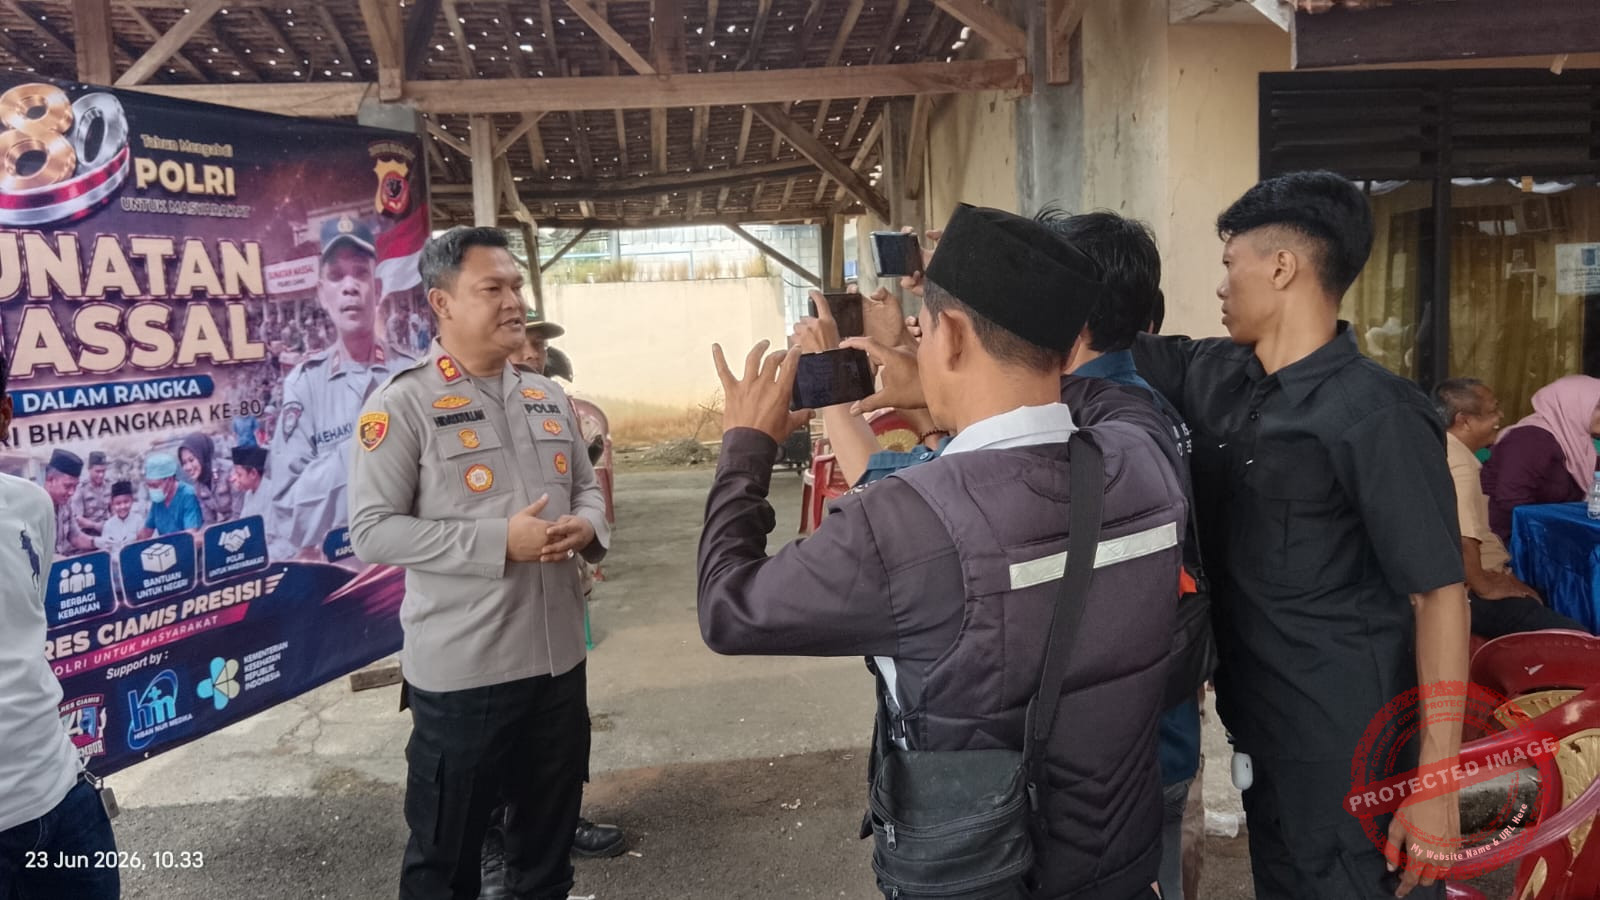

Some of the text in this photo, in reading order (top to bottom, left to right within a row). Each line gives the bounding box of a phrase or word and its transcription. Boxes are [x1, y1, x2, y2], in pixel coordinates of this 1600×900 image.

[134, 157, 236, 196] POLRI
[120, 197, 168, 212] UNTUK
[22, 379, 202, 412] DALAM RANGKA
[524, 403, 561, 414] POLRI
[29, 407, 202, 444] BHAYANGKARA
[136, 579, 189, 600] UNTUK NEGERI
[143, 572, 182, 589] BANTUAN
[58, 602, 100, 620] KEBAIKAN
[60, 593, 97, 610] BERBAGI
[97, 605, 178, 646] CIAMIS
[181, 580, 262, 619] PRESISI
[94, 643, 136, 664] UNTUK
[141, 615, 219, 651] MASYARAKAT
[106, 654, 148, 680] Support
[149, 653, 162, 668] by
[244, 652, 281, 673] KESEHATAN
[244, 670, 281, 692] INDONESIA
